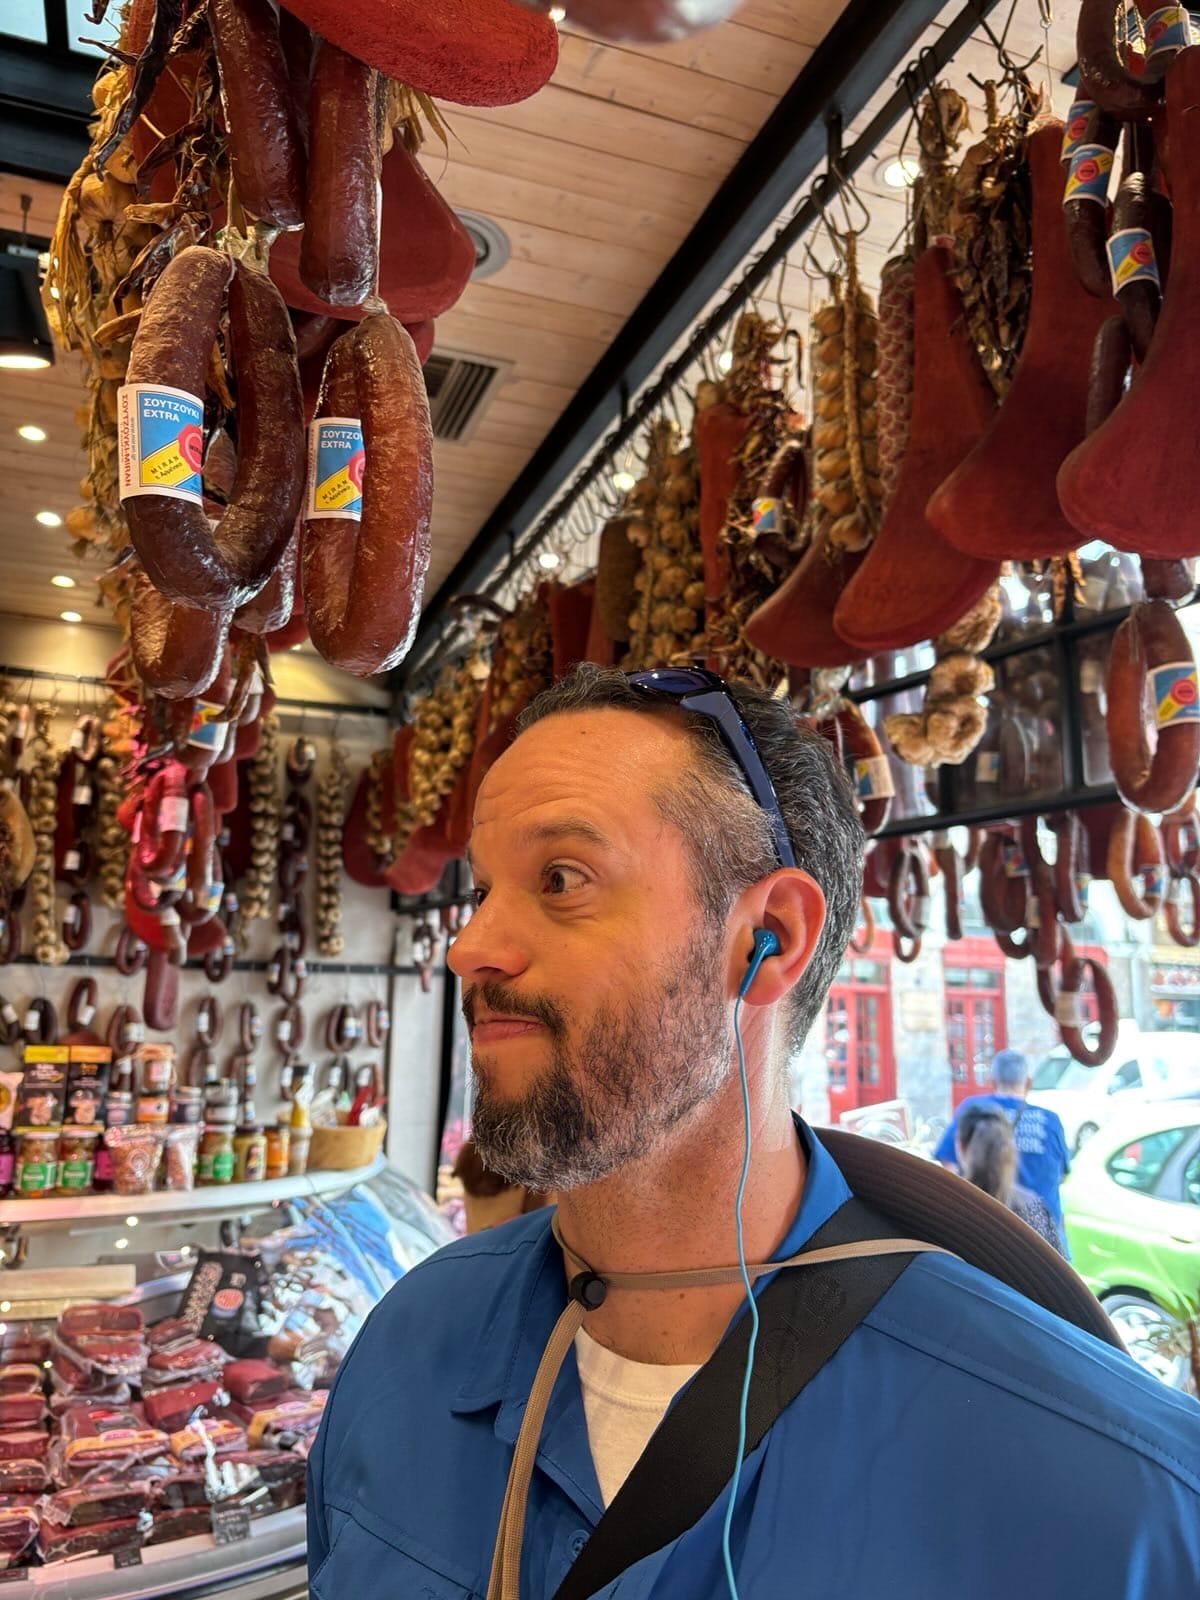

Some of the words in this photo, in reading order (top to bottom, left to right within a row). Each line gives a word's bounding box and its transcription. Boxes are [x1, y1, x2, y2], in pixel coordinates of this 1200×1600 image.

[143, 397, 200, 420] ΣΟΥΤΖΟΥΚΙ
[143, 408, 180, 423] EXTRA
[321, 430, 362, 441] ΣΟΥΤΖΟ
[320, 441, 352, 450] EXTRA
[150, 455, 180, 475] MIRAN
[322, 479, 348, 500] MIRAN
